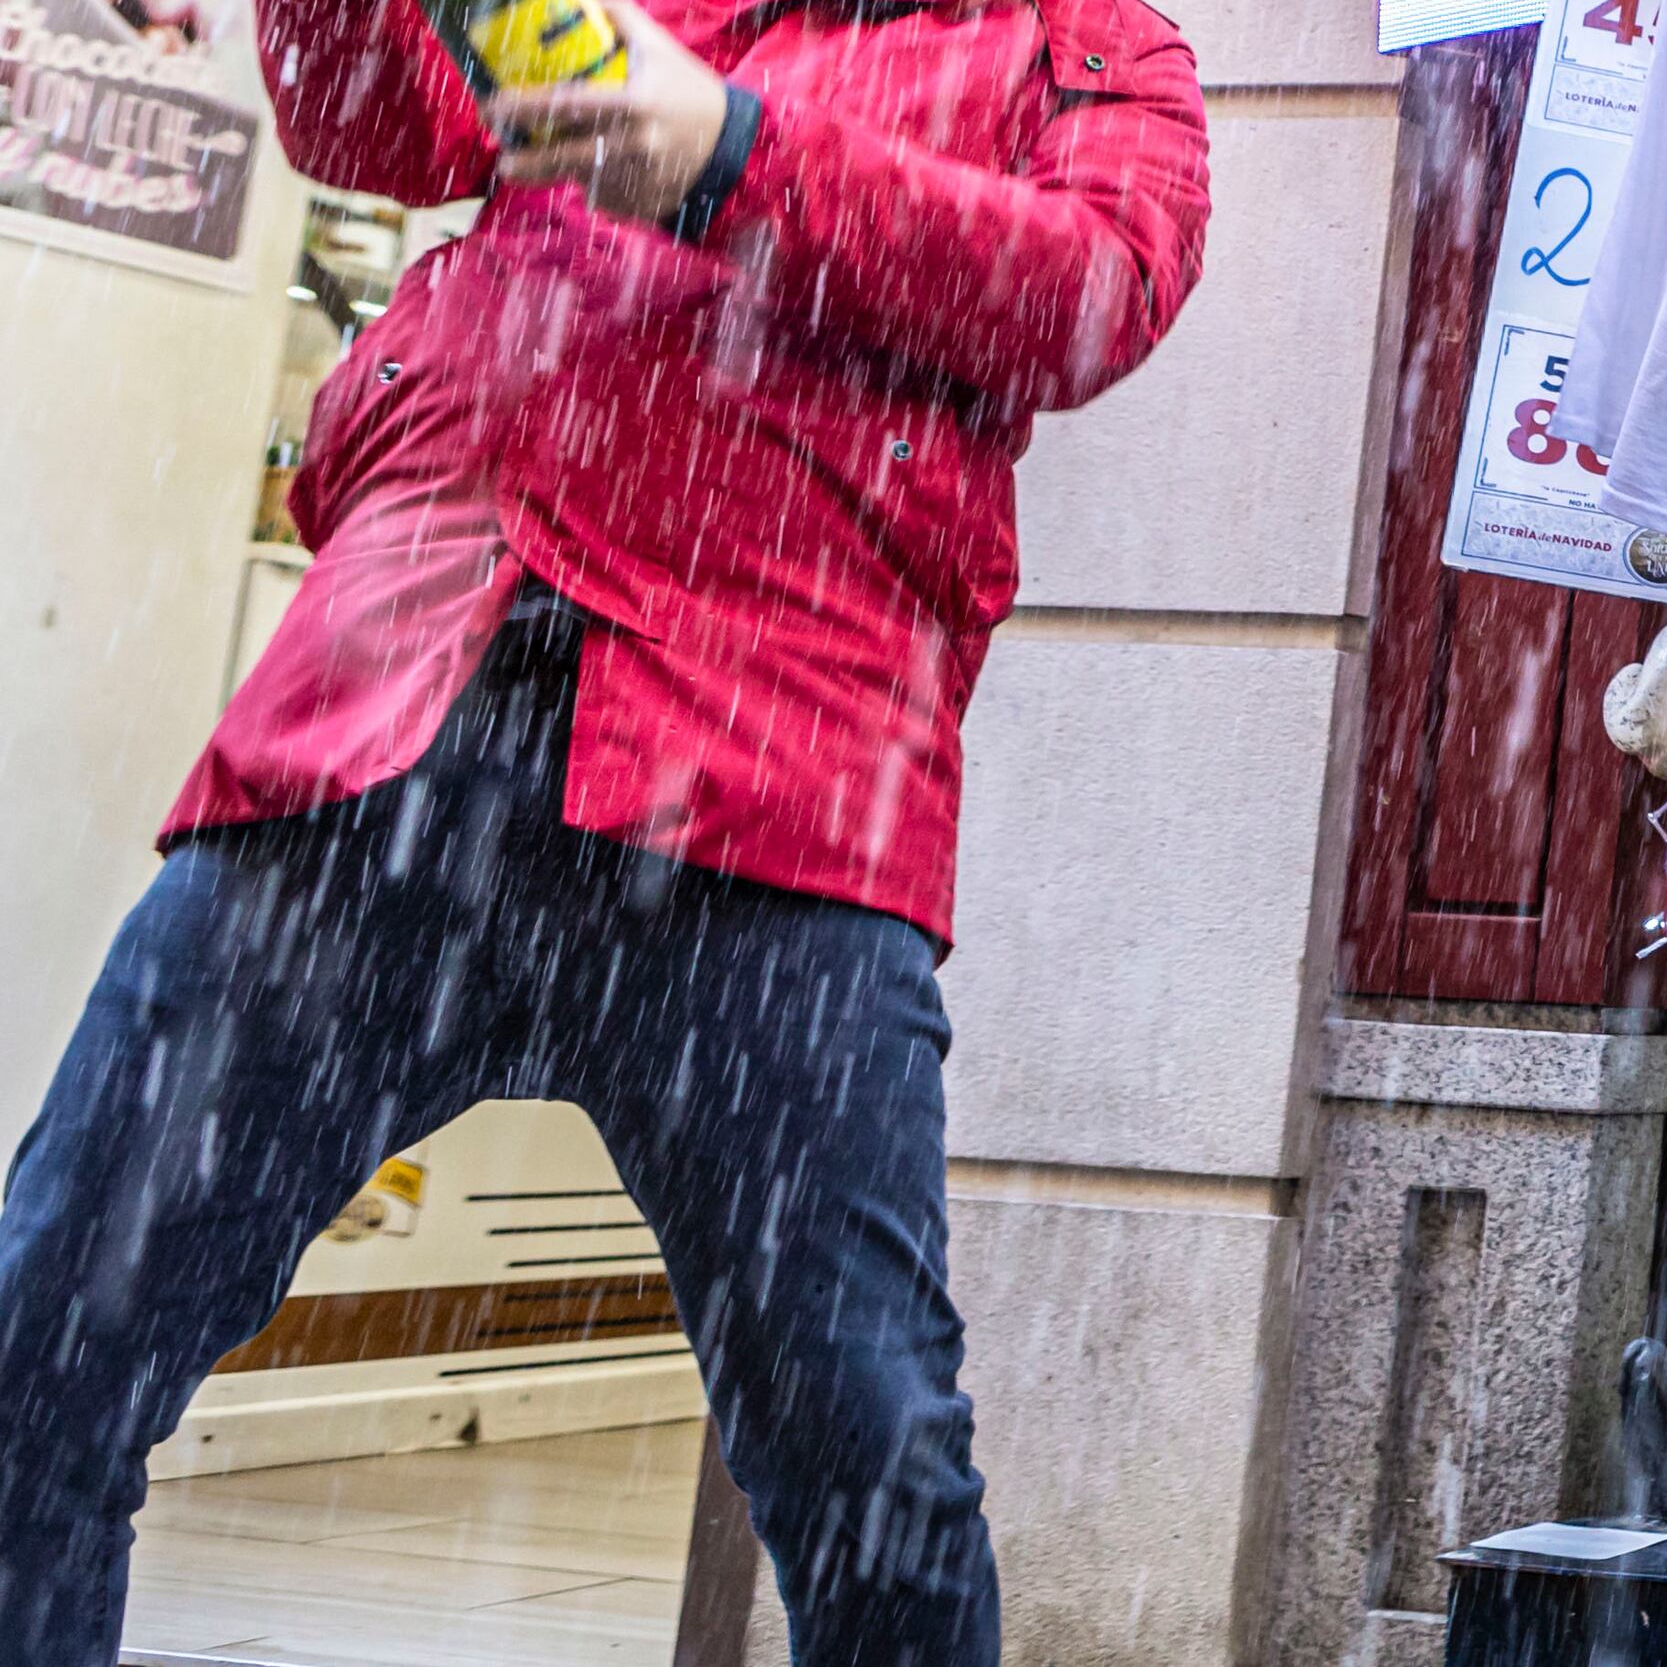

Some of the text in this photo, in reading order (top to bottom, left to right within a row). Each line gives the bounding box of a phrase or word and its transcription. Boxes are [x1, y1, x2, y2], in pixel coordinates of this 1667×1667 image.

[1565, 91, 1614, 109] LOTERÍA
[1484, 522, 1537, 541] LOTERÍA
[1552, 534, 1612, 552] NAVIDAD
